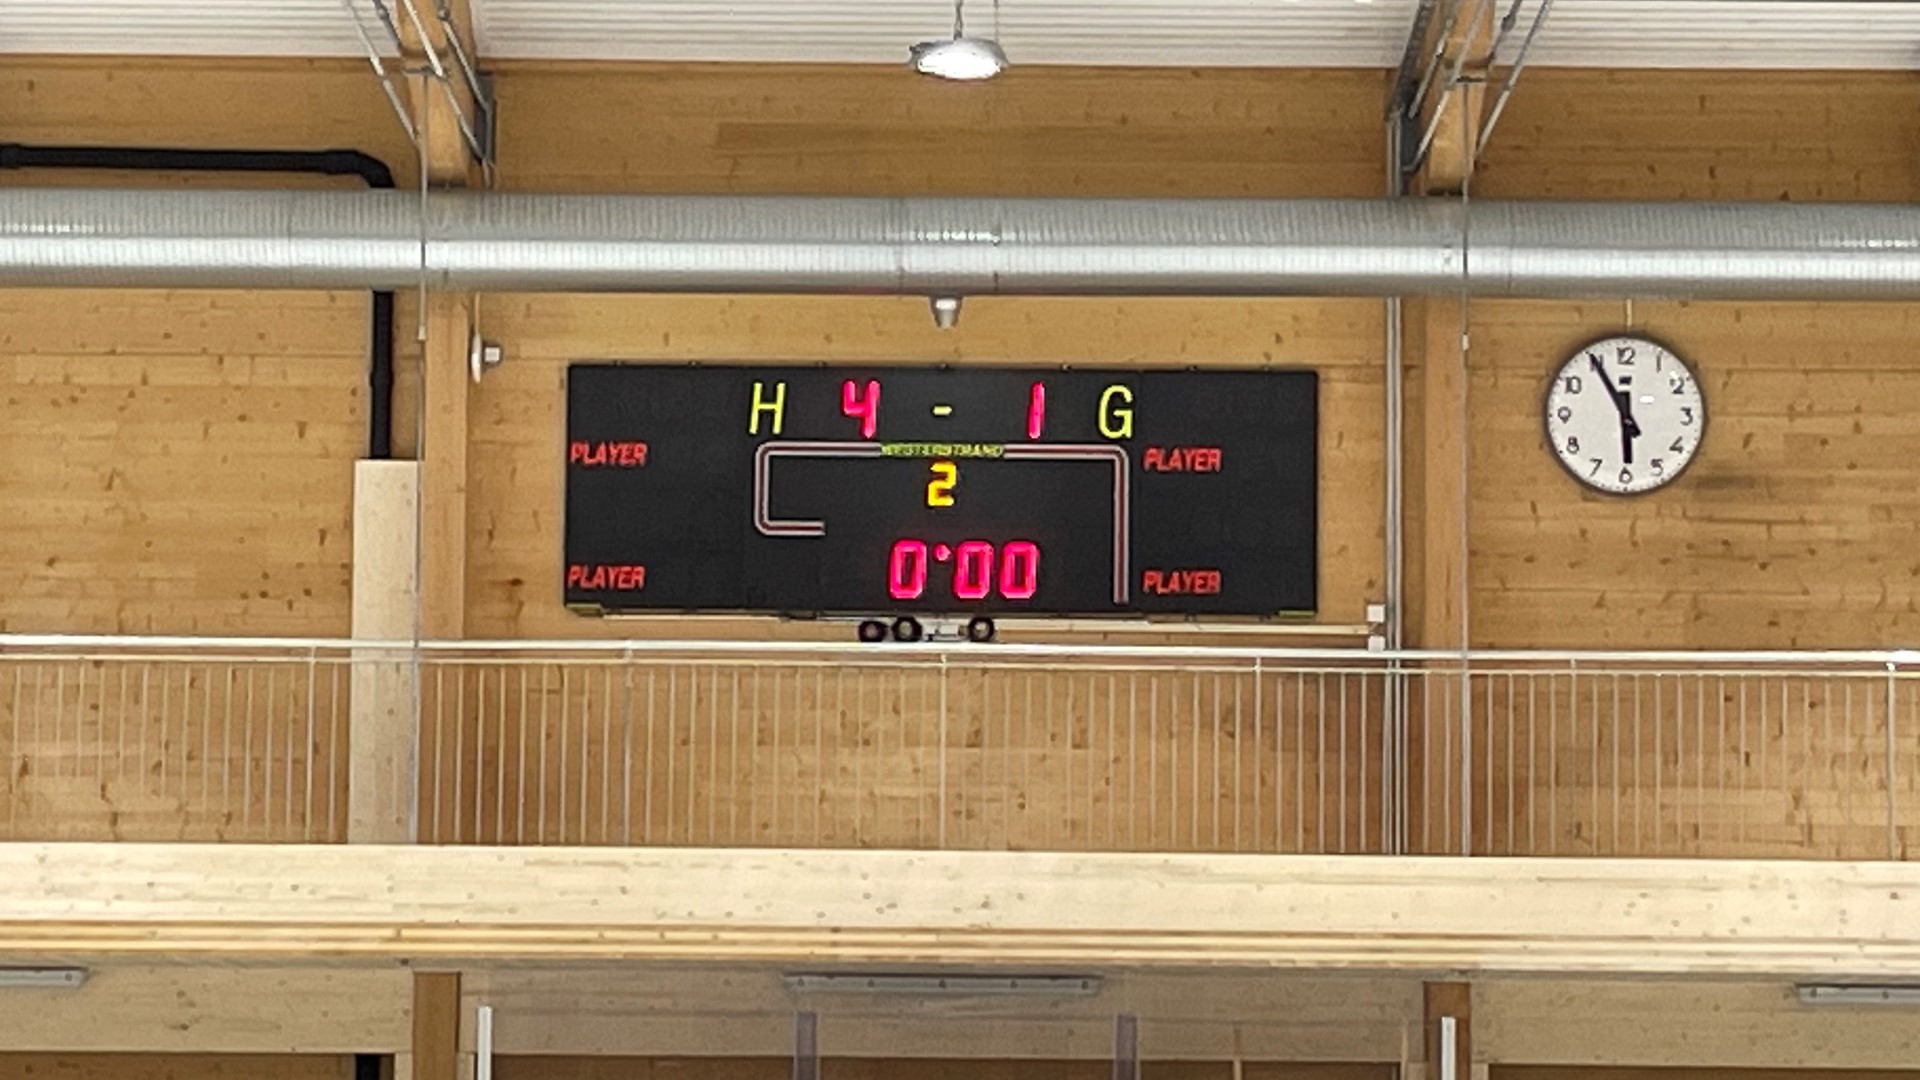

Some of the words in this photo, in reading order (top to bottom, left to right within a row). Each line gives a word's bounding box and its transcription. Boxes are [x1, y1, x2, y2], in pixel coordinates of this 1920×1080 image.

[1616, 347, 1636, 365] 12
[1565, 375, 1582, 395] 10
[1669, 376, 1685, 395] 2
[749, 382, 786, 435] H
[842, 380, 881, 438] 4
[1028, 381, 1045, 439] 1
[1098, 384, 1134, 439] G
[1557, 406, 1572, 424] 9
[1679, 406, 1694, 426] 3
[570, 441, 648, 466] PLAYER
[1566, 436, 1580, 454] 8
[1669, 436, 1684, 454] 4
[1143, 447, 1222, 473] PLAYER
[1589, 458, 1603, 477] 7
[1650, 458, 1664, 477] 5
[927, 461, 957, 507] 2
[1618, 467, 1633, 484] 6
[567, 564, 645, 589] PLAYER
[1143, 569, 1222, 595] PLAYER
